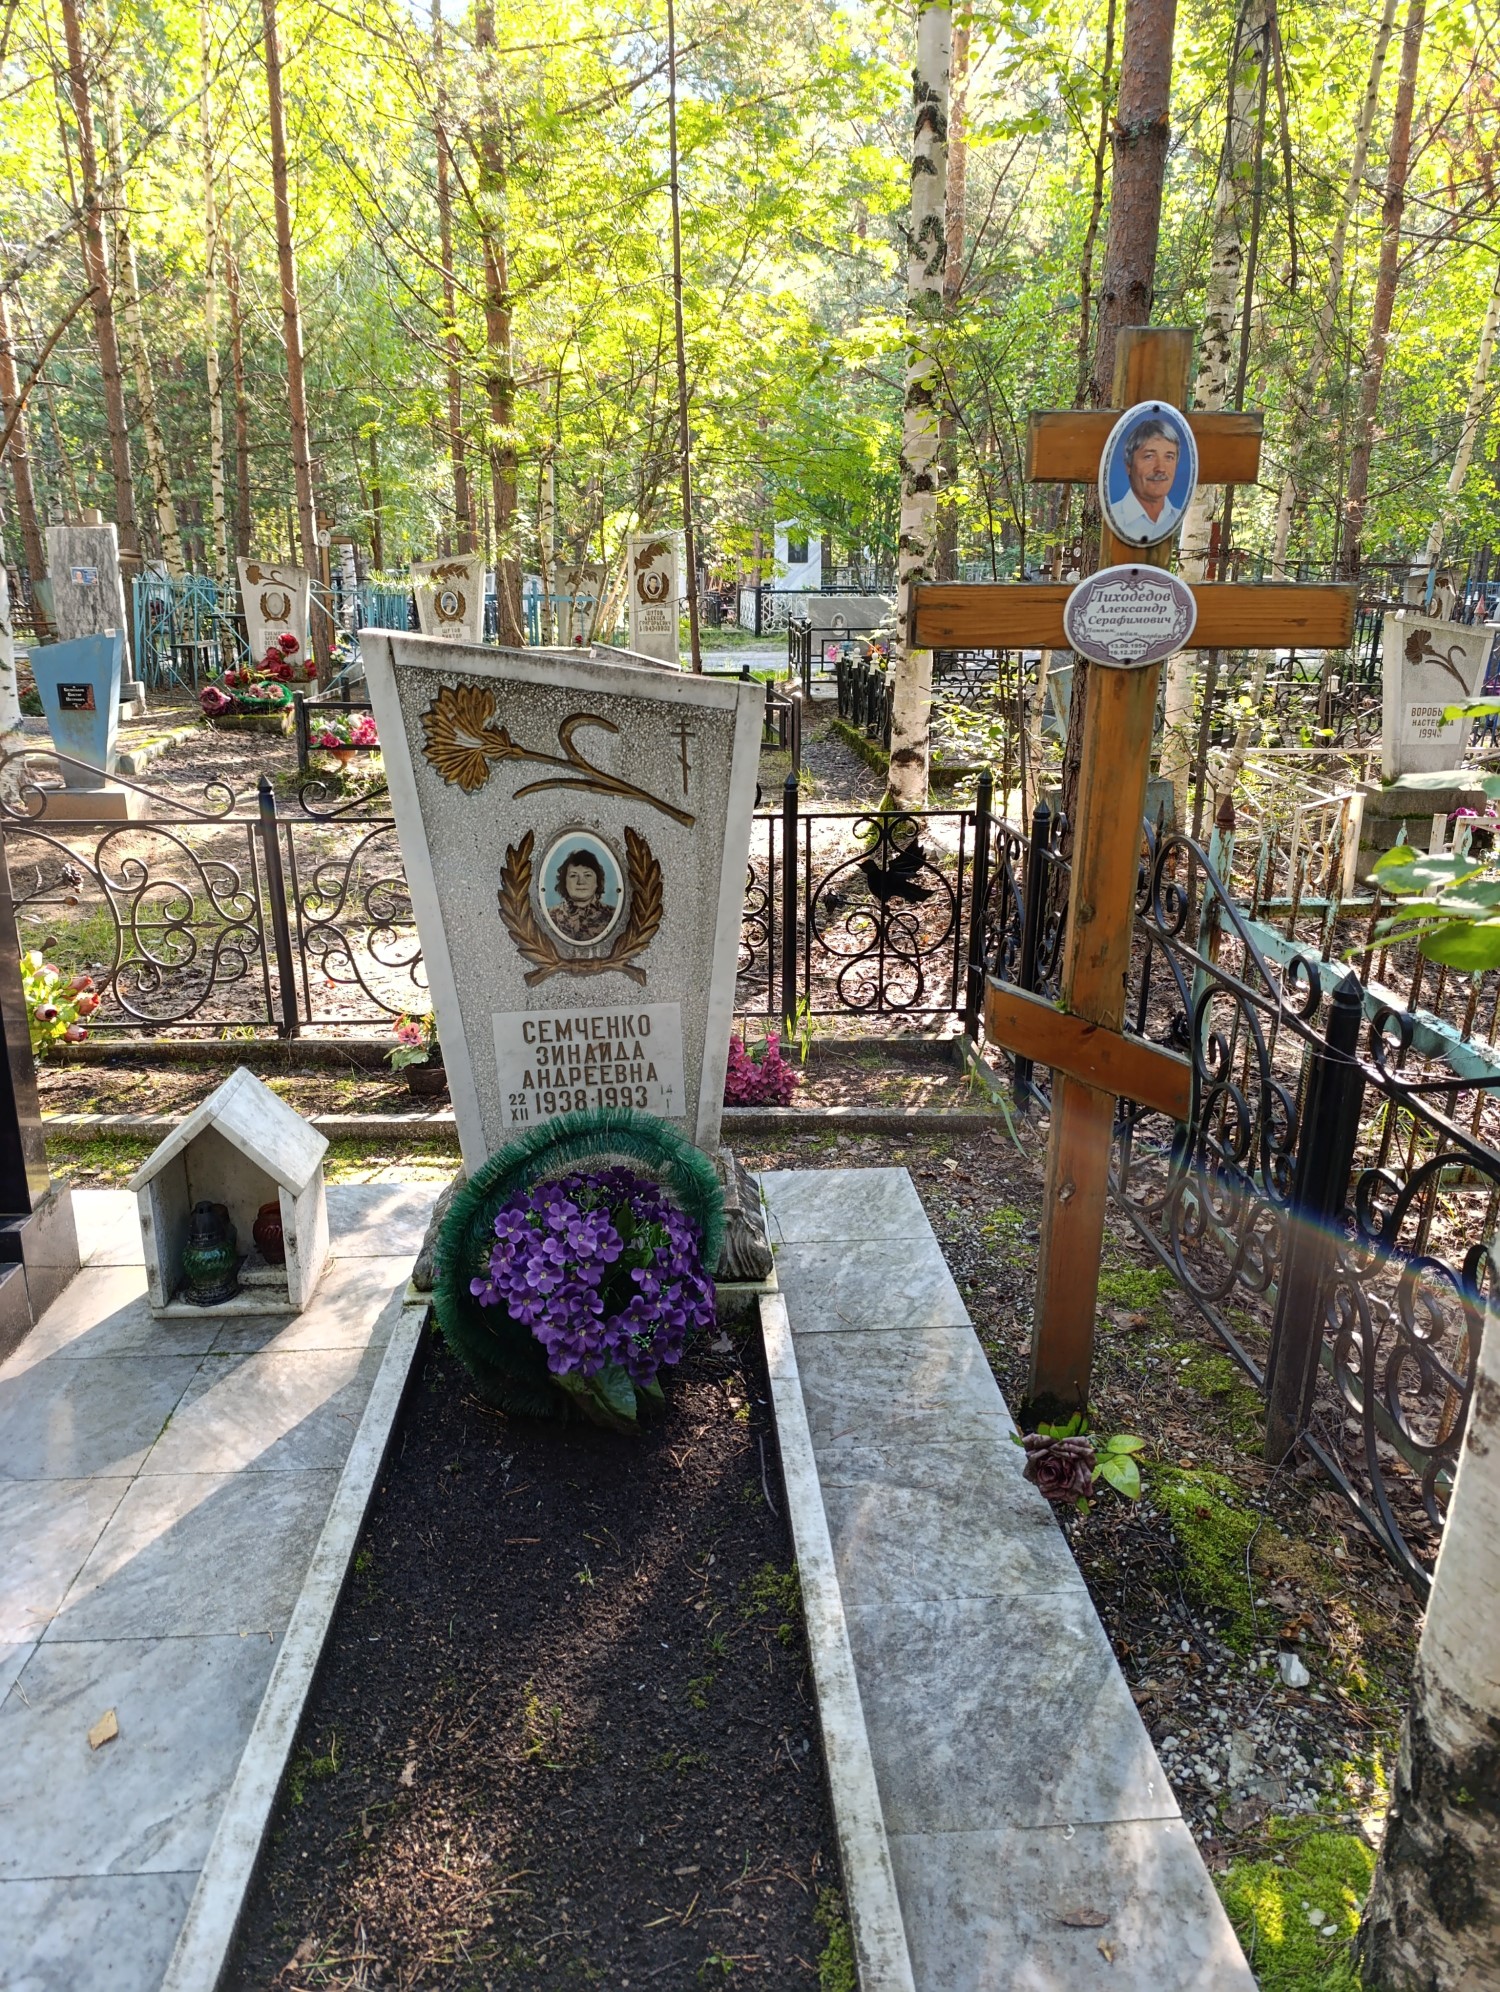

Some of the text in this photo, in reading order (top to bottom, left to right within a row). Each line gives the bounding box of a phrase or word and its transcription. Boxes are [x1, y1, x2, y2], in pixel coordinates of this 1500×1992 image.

[1090, 590, 1172, 603] Лиходедов
[1096, 603, 1167, 616] Александр
[1088, 615, 1171, 627] Серафимович
[1411, 707, 1443, 717] ВОРОБЬ
[522, 1014, 651, 1044] СЕМЧЕНКО
[535, 1040, 645, 1066] ЗИНАИДА
[522, 1062, 658, 1090] АНДРЕЕВНА
[508, 1093, 527, 1106] 22
